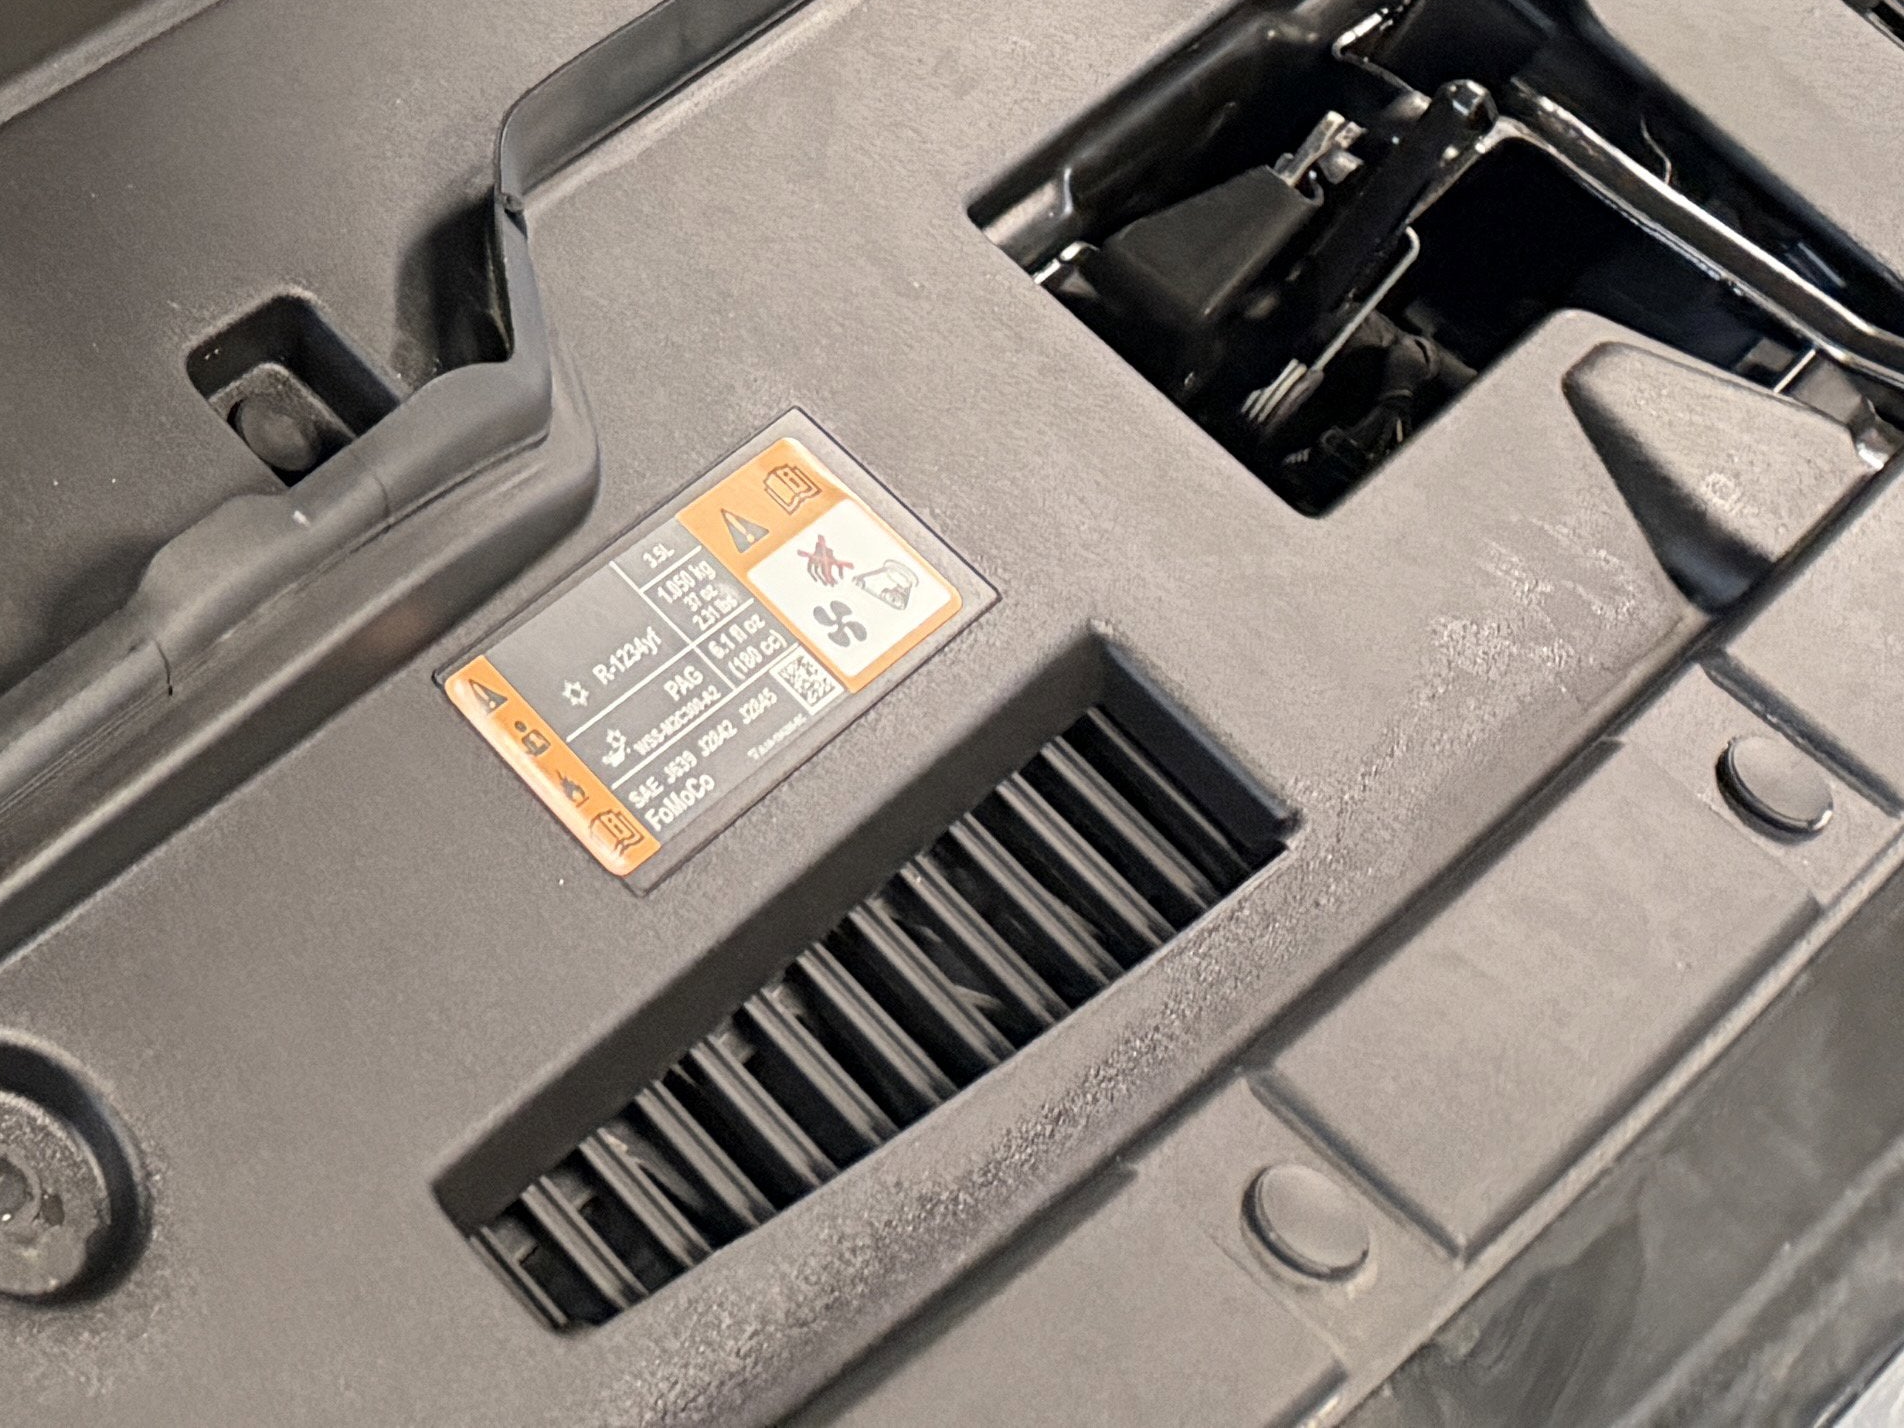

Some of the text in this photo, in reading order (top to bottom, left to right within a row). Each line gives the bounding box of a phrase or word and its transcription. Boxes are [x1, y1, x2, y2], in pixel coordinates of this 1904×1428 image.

[640, 539, 676, 569] 3.5L
[654, 556, 719, 605] 1.050 kg
[589, 624, 669, 690] R-1234yf
[704, 612, 767, 660] 6.1 fl oz
[725, 627, 790, 681] (180 cc)
[661, 663, 707, 702] PAG
[625, 774, 667, 810] SAE
[641, 767, 719, 833] FoMoCo
